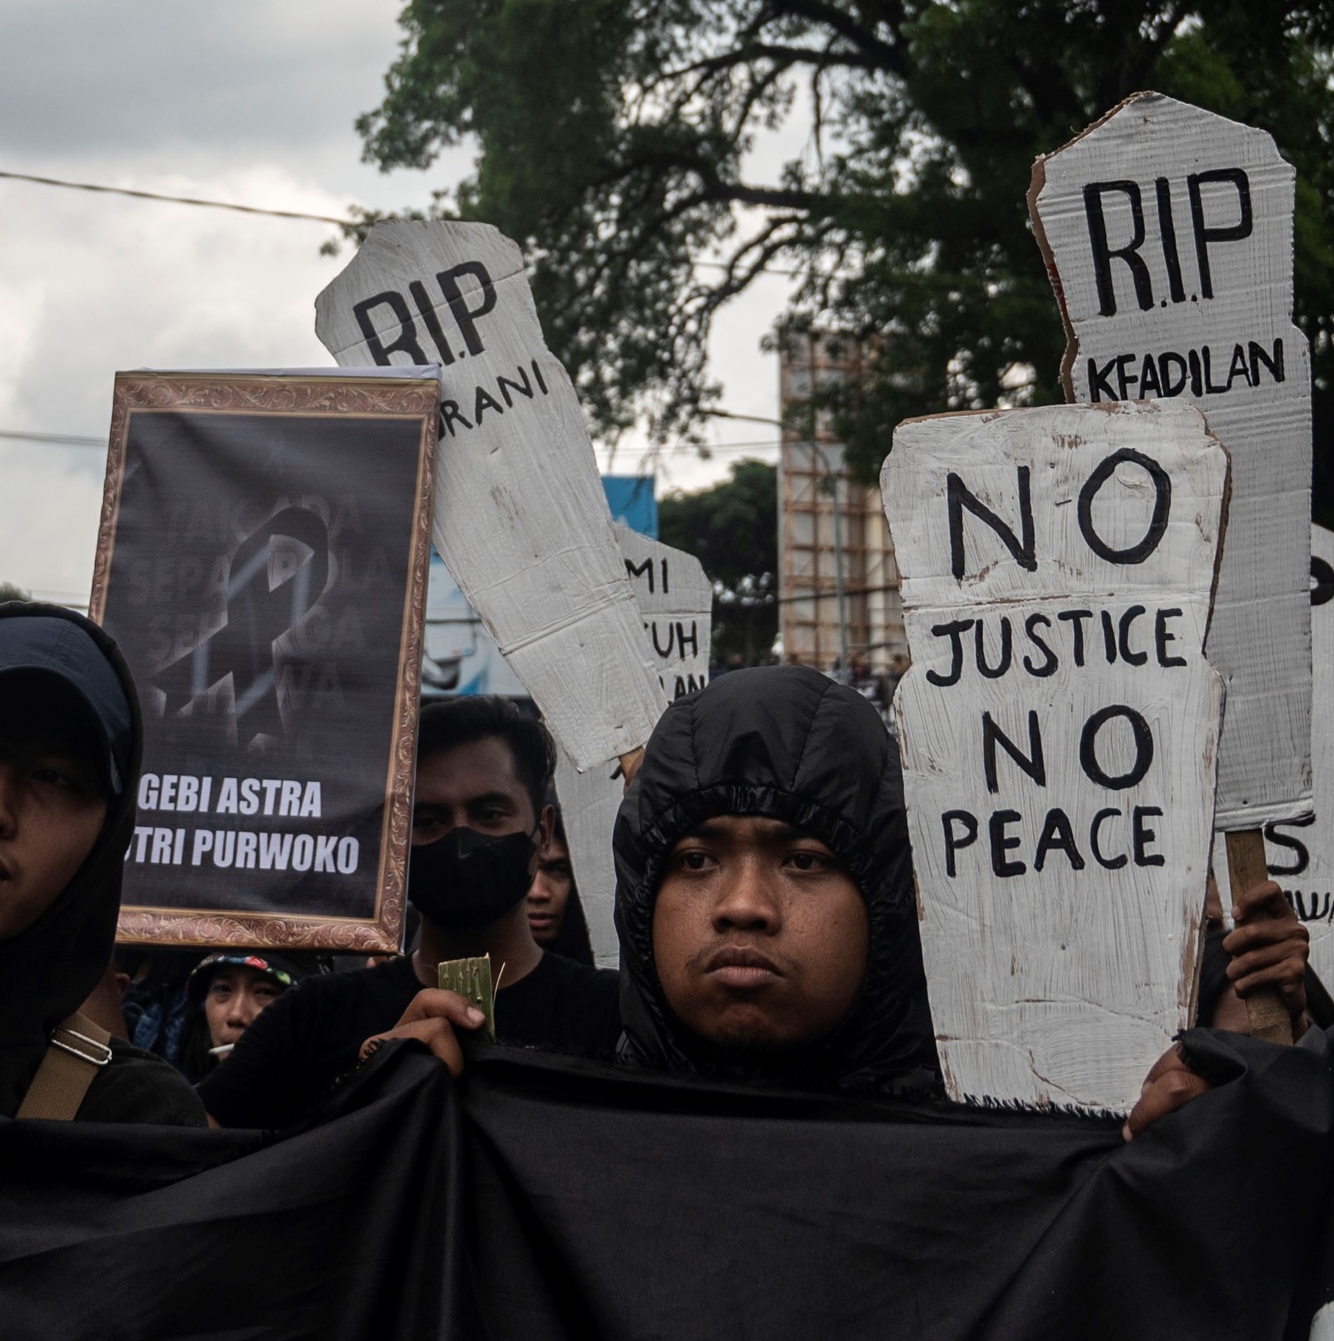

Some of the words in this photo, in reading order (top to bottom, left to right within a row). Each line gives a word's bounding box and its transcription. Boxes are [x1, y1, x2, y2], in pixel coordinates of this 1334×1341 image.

[438, 359, 549, 441] RANI
[946, 447, 1172, 580] NO
[926, 605, 1188, 687] JUSTICE
[982, 704, 1155, 794] NO
[138, 773, 212, 813] GEBI
[216, 776, 322, 818] ASTRA
[192, 829, 360, 875] PURWOKO
[941, 806, 1165, 878] PEACE
